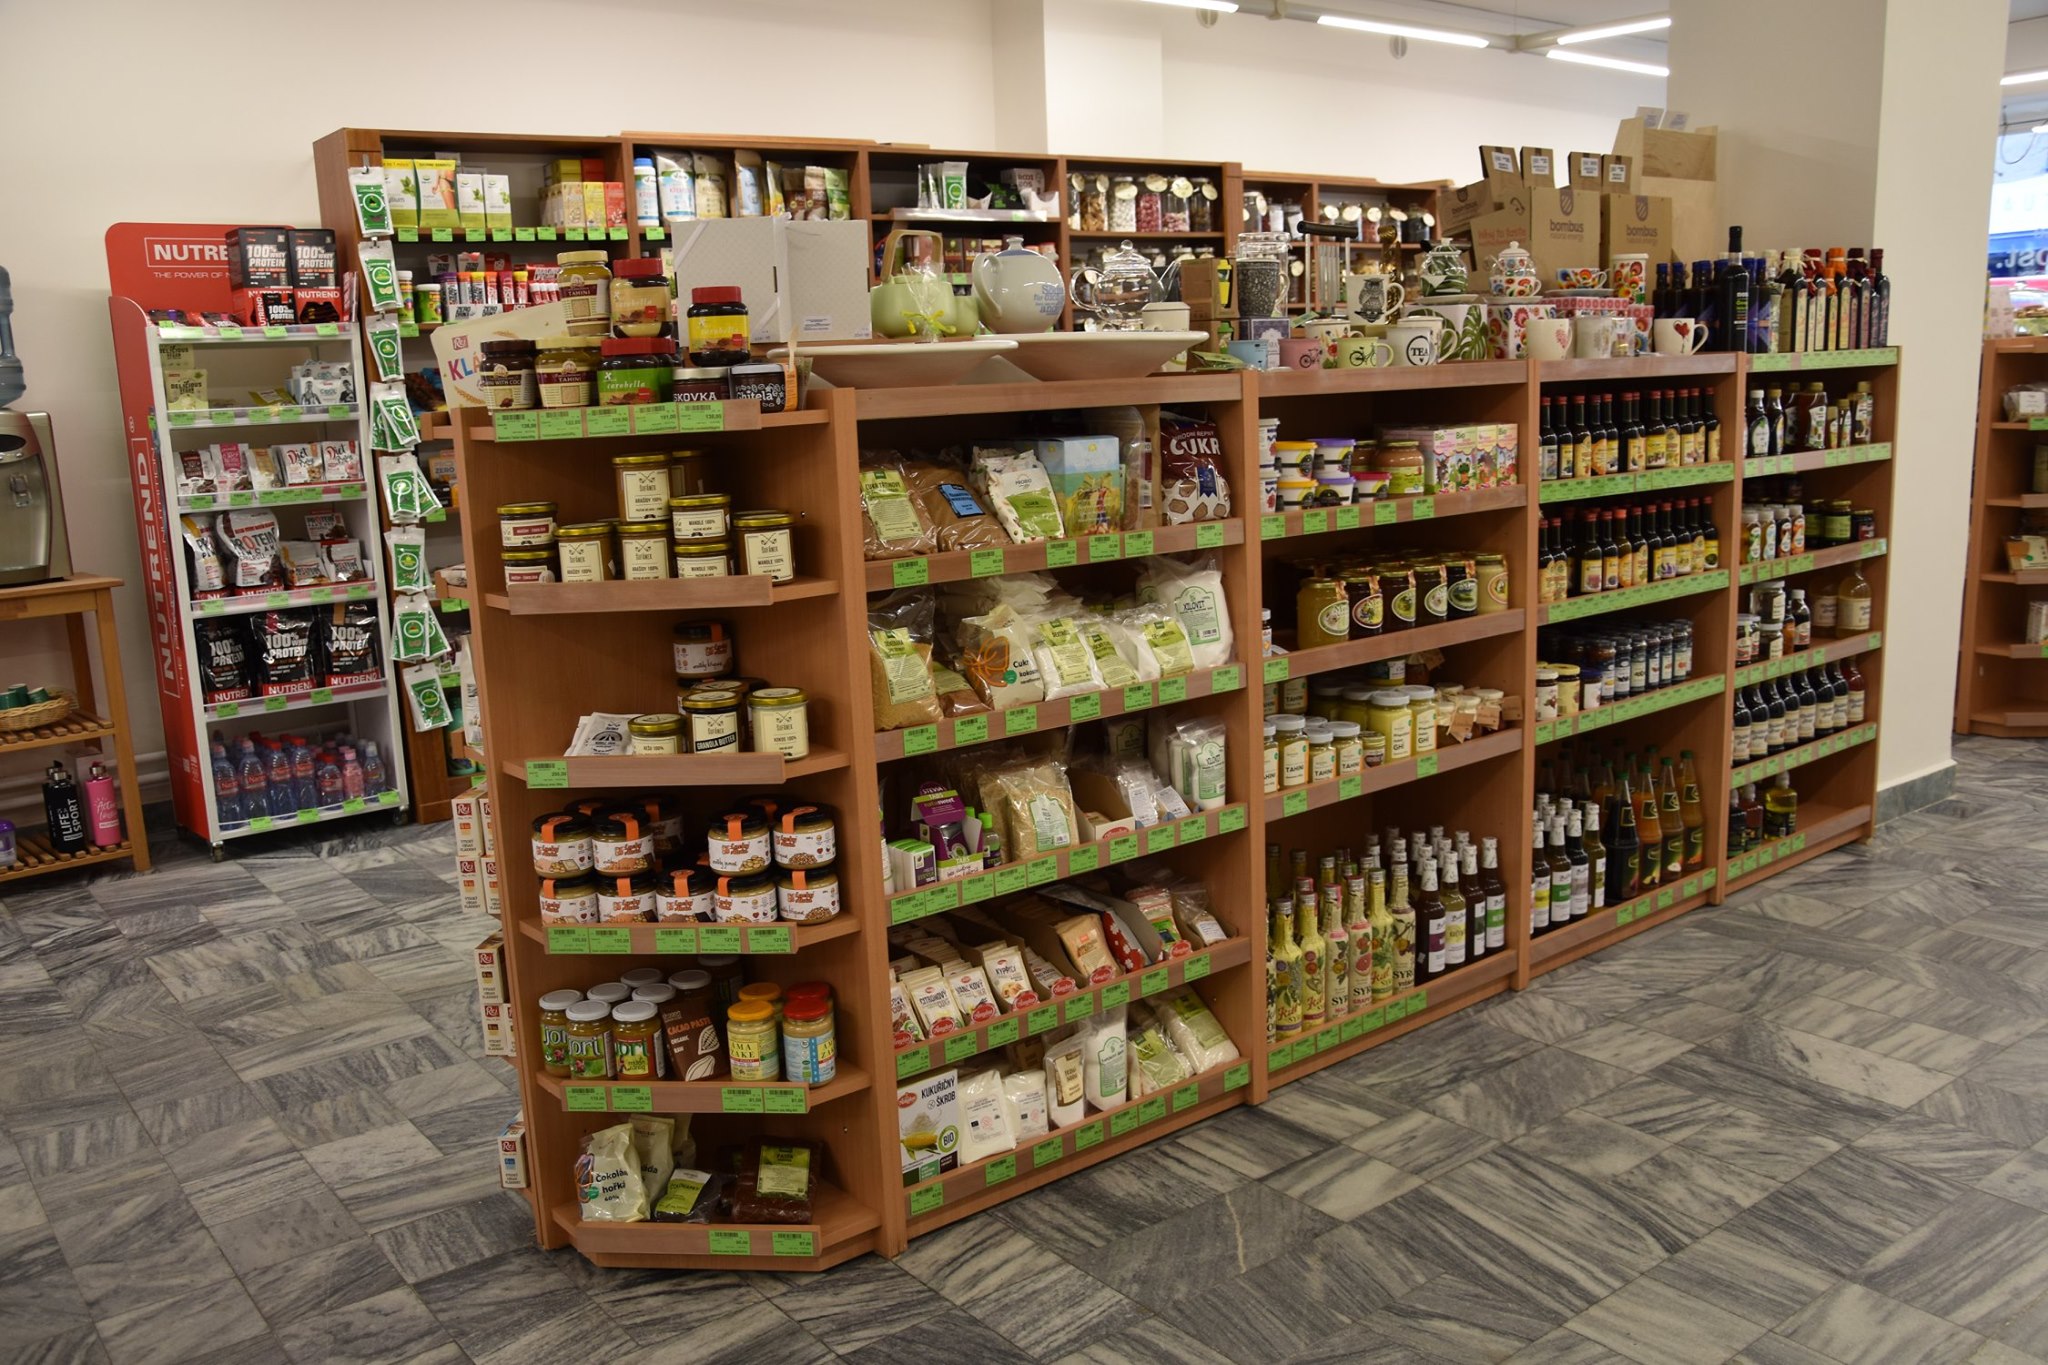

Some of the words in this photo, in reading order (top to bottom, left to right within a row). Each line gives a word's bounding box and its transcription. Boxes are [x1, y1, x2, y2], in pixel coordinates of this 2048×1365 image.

[1550, 219, 1584, 232] bombus
[1626, 225, 1657, 237] bombus
[249, 258, 286, 267] PROTEIN
[299, 259, 334, 268] PROTEIN
[298, 291, 340, 299] NUTREND
[1411, 348, 1428, 356] TEA
[171, 382, 202, 390] DELICIOUS
[1170, 438, 1221, 455] CUKR
[435, 466, 455, 474] ZERO
[137, 450, 175, 681] NUTREND
[266, 632, 300, 648] 100%
[332, 626, 364, 642] 100%
[697, 740, 719, 750] GRANOLA
[719, 734, 736, 745] BUTTER
[922, 786, 945, 794] STEVIA
[67, 799, 82, 832] SPORT
[668, 1022, 690, 1036] CACAO
[731, 1042, 751, 1050] AMA
[731, 1050, 755, 1059] ZAKE
[921, 1076, 955, 1099] KUKUŘIČNÝ
[936, 1091, 956, 1107] ŠKROB
[943, 1132, 954, 1146] BIO
